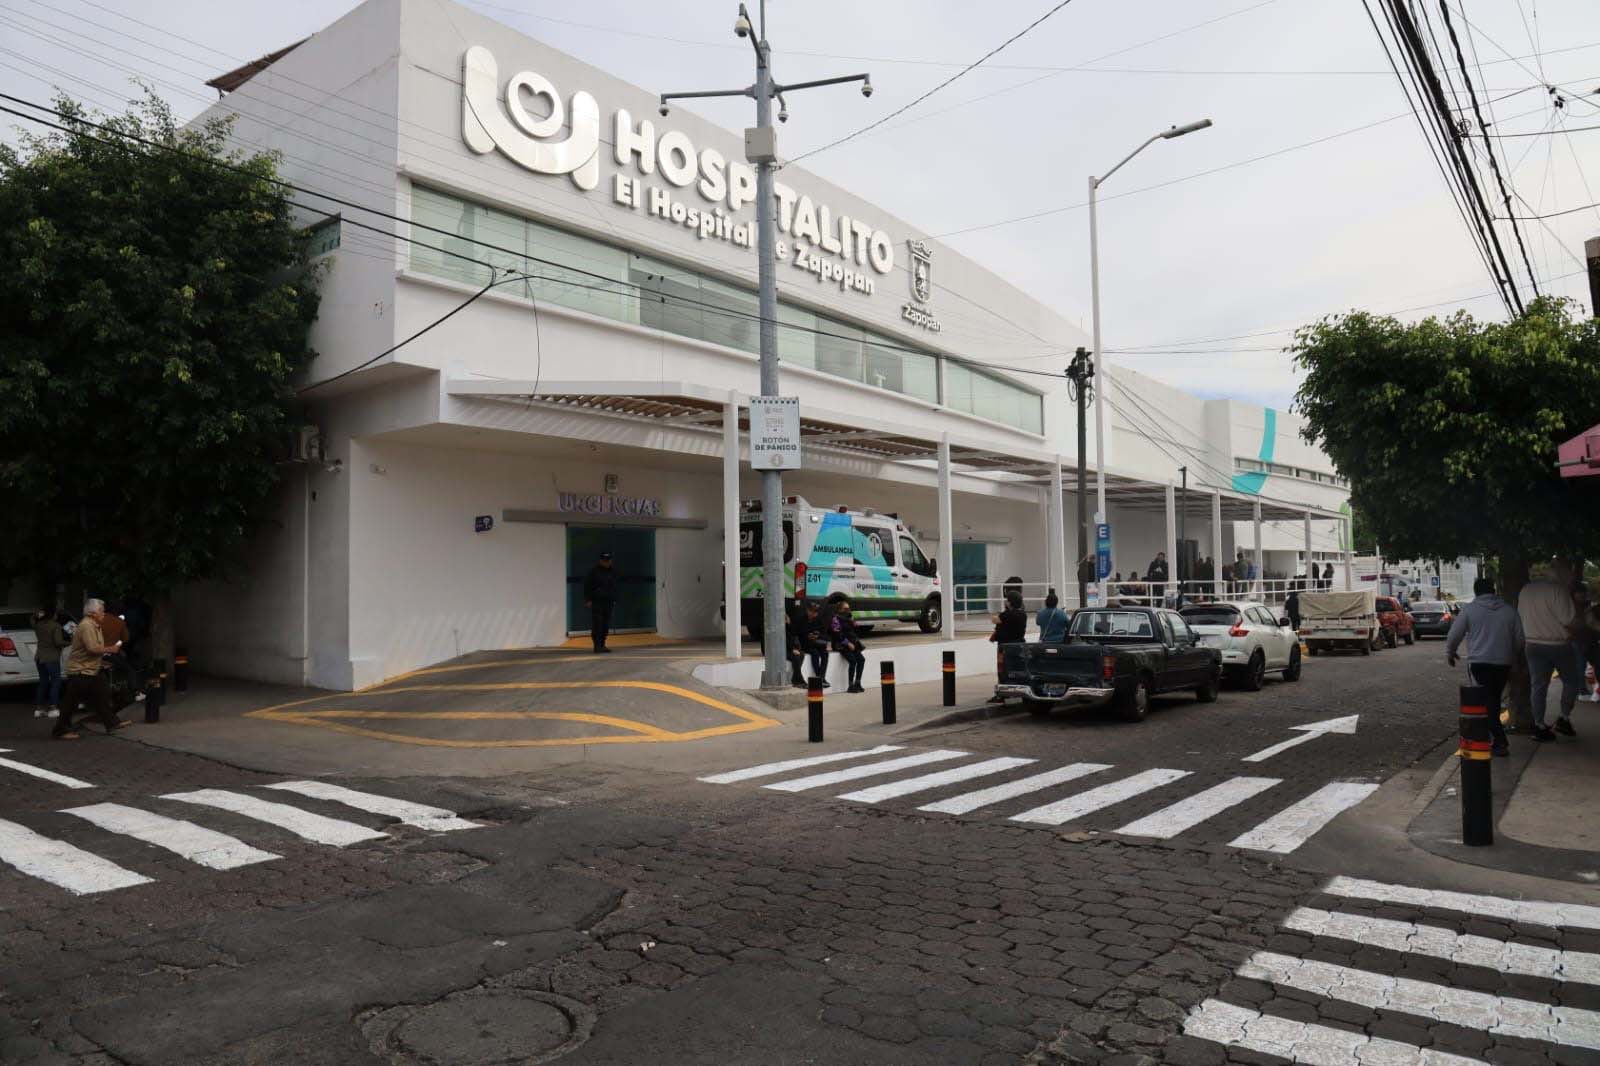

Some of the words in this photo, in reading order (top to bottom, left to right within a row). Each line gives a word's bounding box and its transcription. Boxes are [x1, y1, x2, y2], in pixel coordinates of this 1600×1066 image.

[616, 109, 893, 273] HOSPTALITO
[616, 173, 641, 208] El
[649, 186, 756, 248] Hospital
[795, 243, 875, 296] Zapopan
[903, 304, 942, 333] Zapopan
[1099, 527, 1107, 538] E
[807, 573, 821, 583] Z-01
